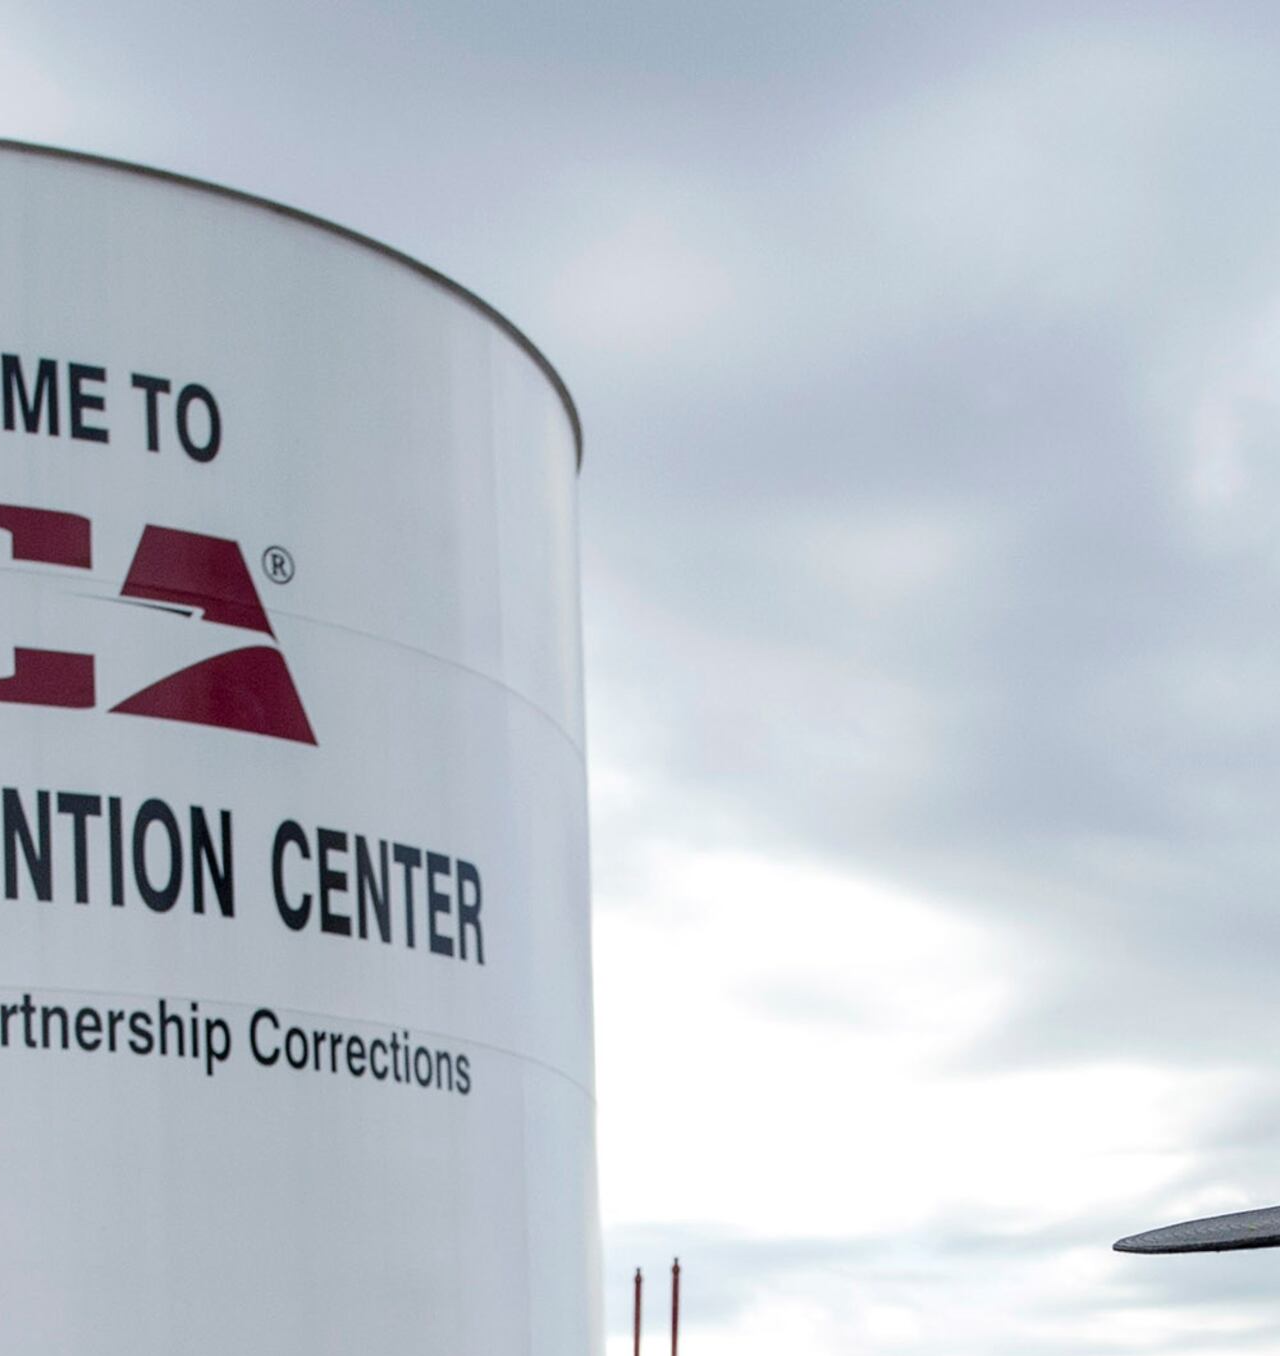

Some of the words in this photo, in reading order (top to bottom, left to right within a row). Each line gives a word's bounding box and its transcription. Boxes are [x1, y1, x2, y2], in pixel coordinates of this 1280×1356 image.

[131, 372, 222, 464] TO
[271, 819, 484, 965] CENTER
[249, 1008, 471, 1095] Corrections
